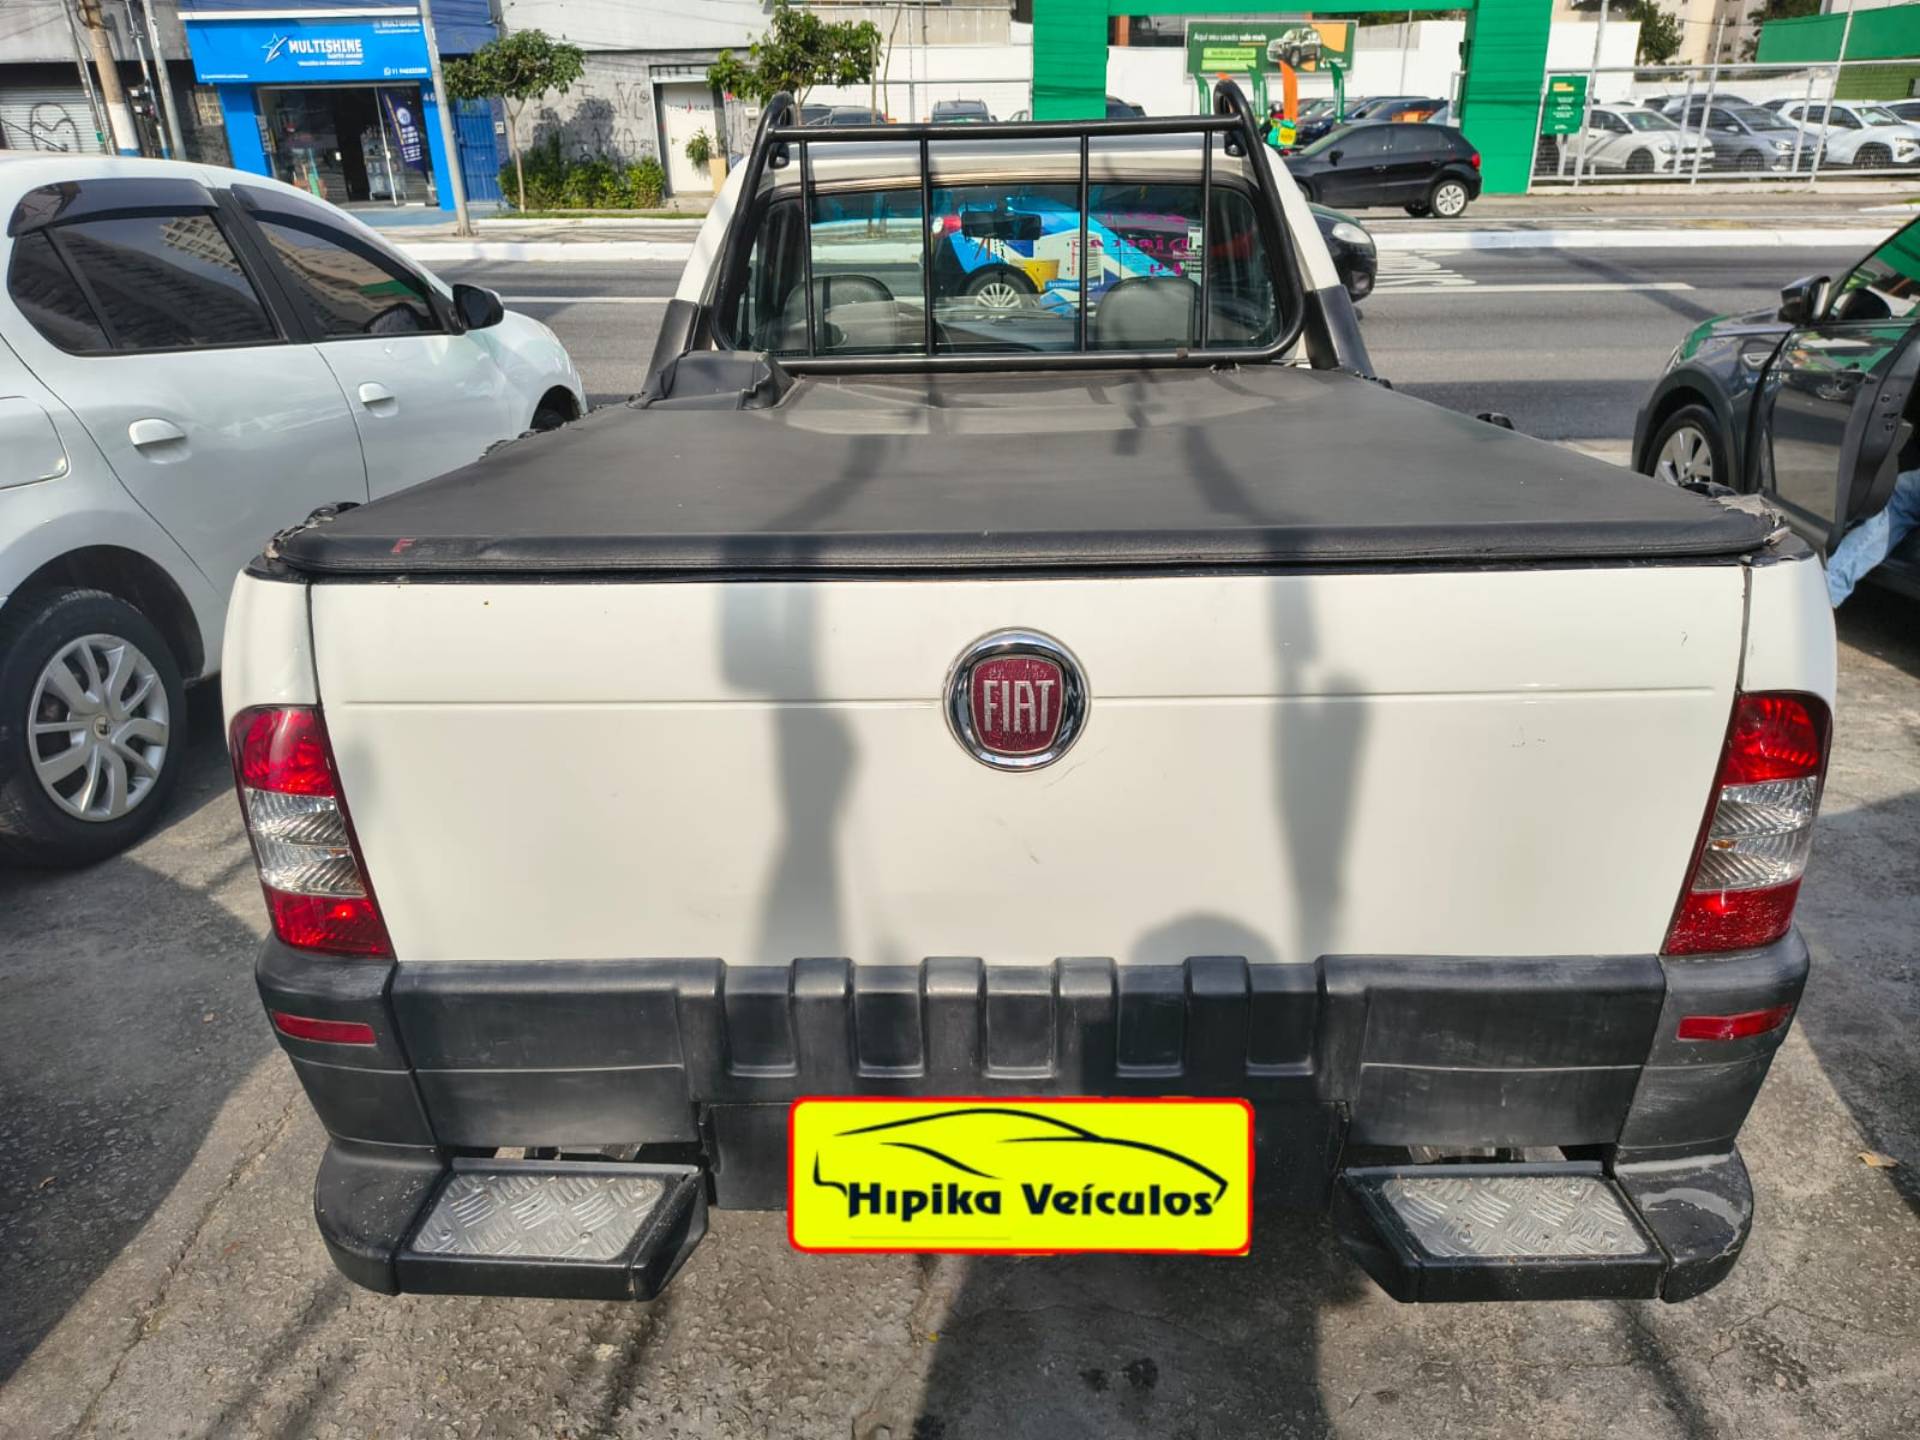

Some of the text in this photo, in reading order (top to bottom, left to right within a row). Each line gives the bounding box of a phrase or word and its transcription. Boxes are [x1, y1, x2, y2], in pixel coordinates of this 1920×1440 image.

[1194, 32, 1208, 42] Aqui
[288, 39, 363, 54] MULTISHINE
[983, 679, 1055, 734] FIAT
